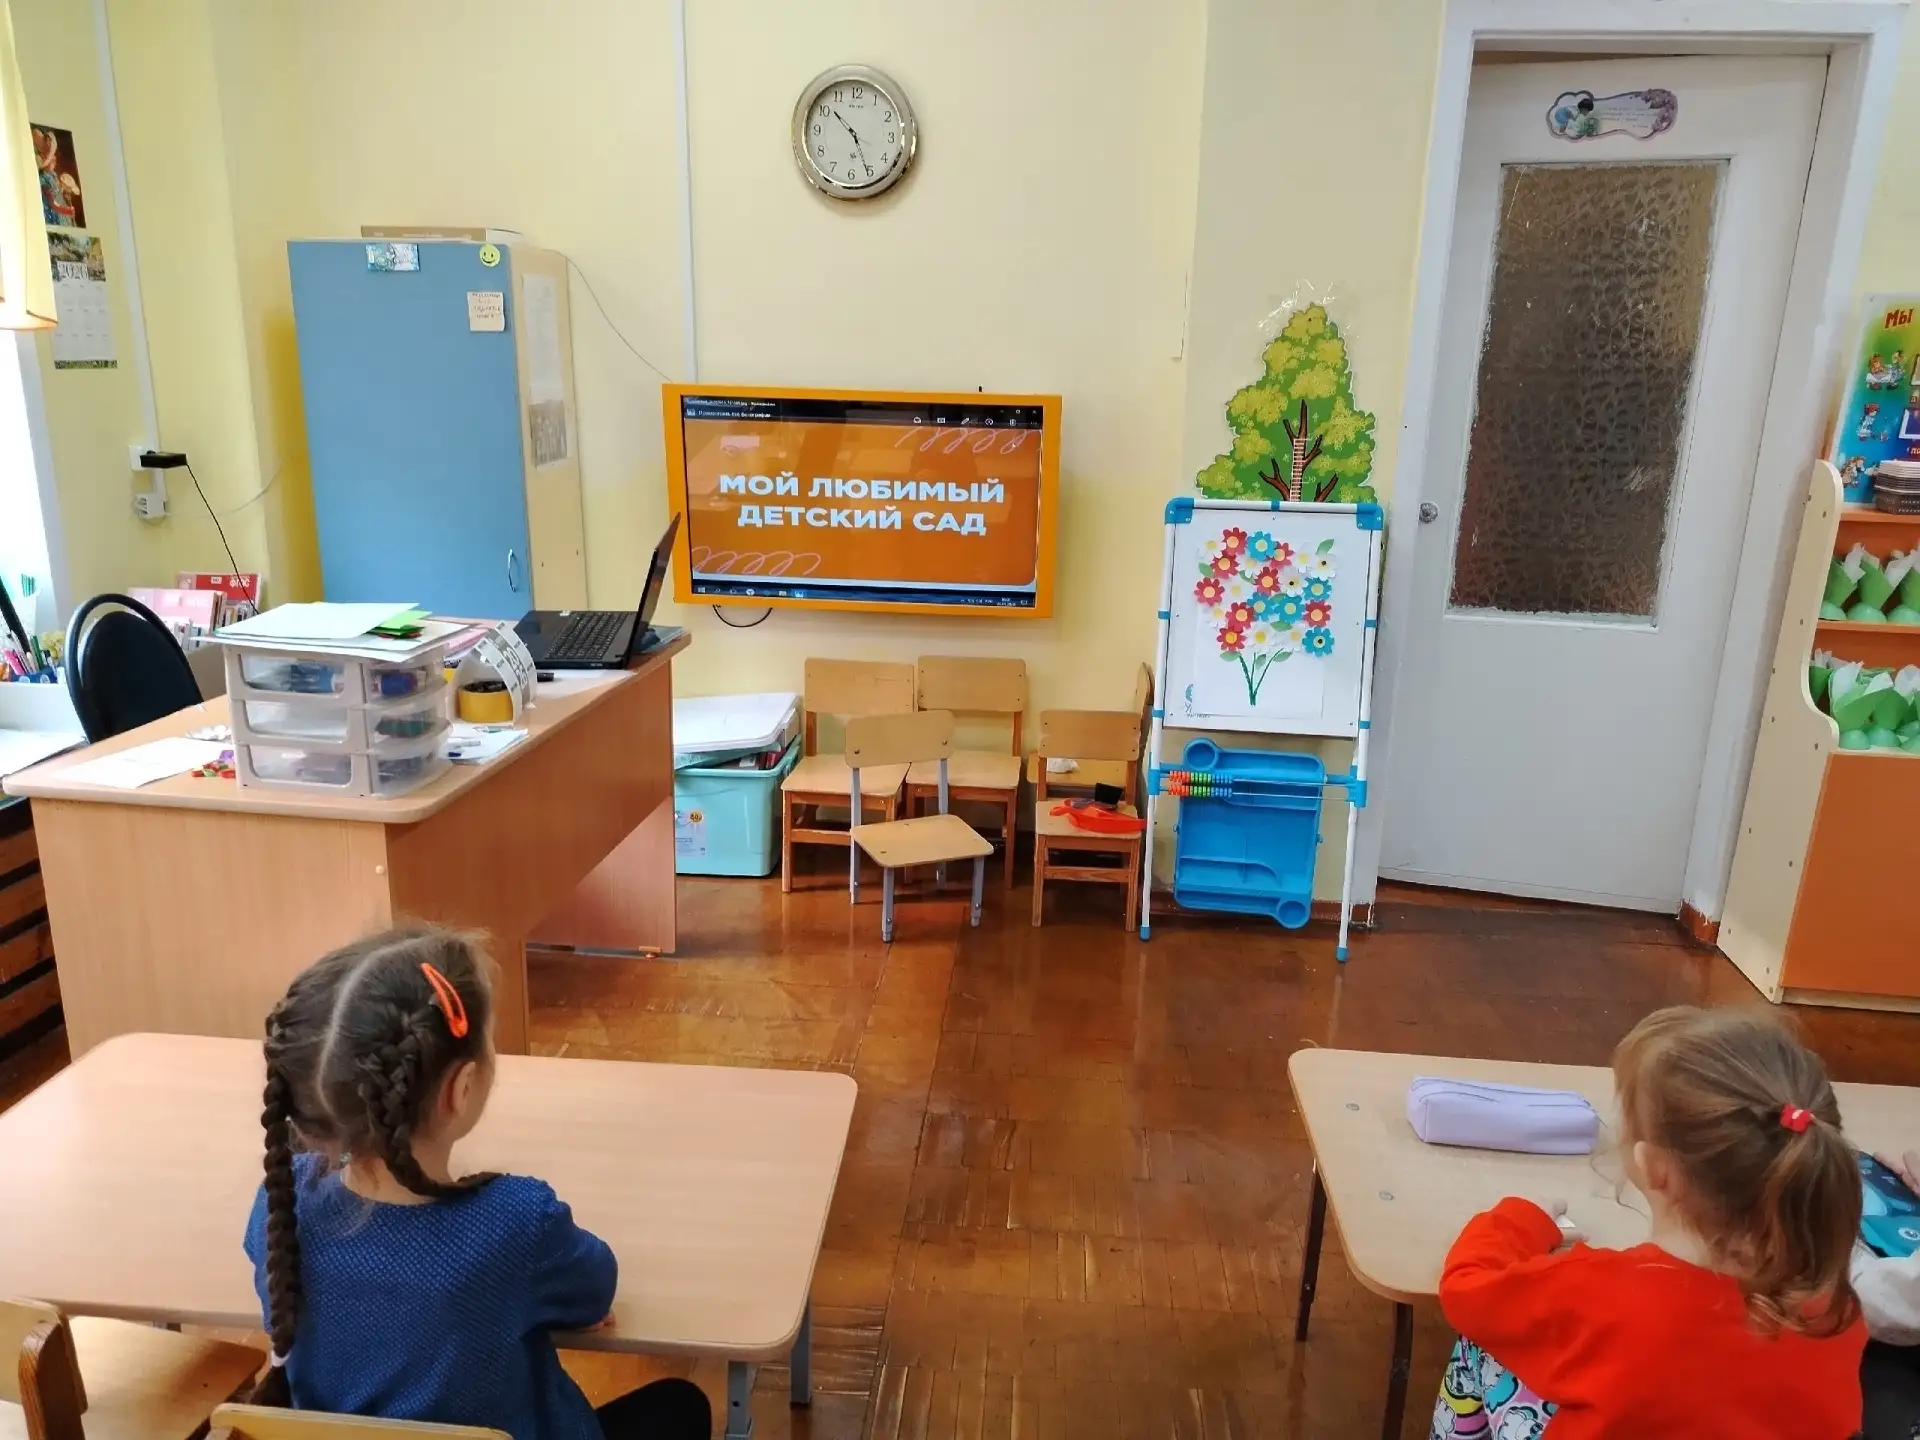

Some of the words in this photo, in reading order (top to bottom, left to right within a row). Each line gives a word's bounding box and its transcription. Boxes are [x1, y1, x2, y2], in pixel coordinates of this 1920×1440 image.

[834, 90, 844, 102] 11
[852, 87, 863, 99] 12
[873, 94, 878, 106] 1
[819, 105, 830, 117] 10
[884, 111, 892, 122] 2
[813, 124, 821, 136] 9
[887, 132, 895, 144] 3
[817, 145, 825, 157] 8
[881, 152, 888, 163] 4
[829, 161, 837, 172] 7
[867, 165, 874, 177] 5
[847, 169, 855, 180] 6
[719, 471, 798, 496] МОЙ
[808, 477, 1004, 504] ЛЮБИМЫЙ
[738, 504, 901, 530] ДЕТСКИЙ
[912, 512, 986, 536] САД
